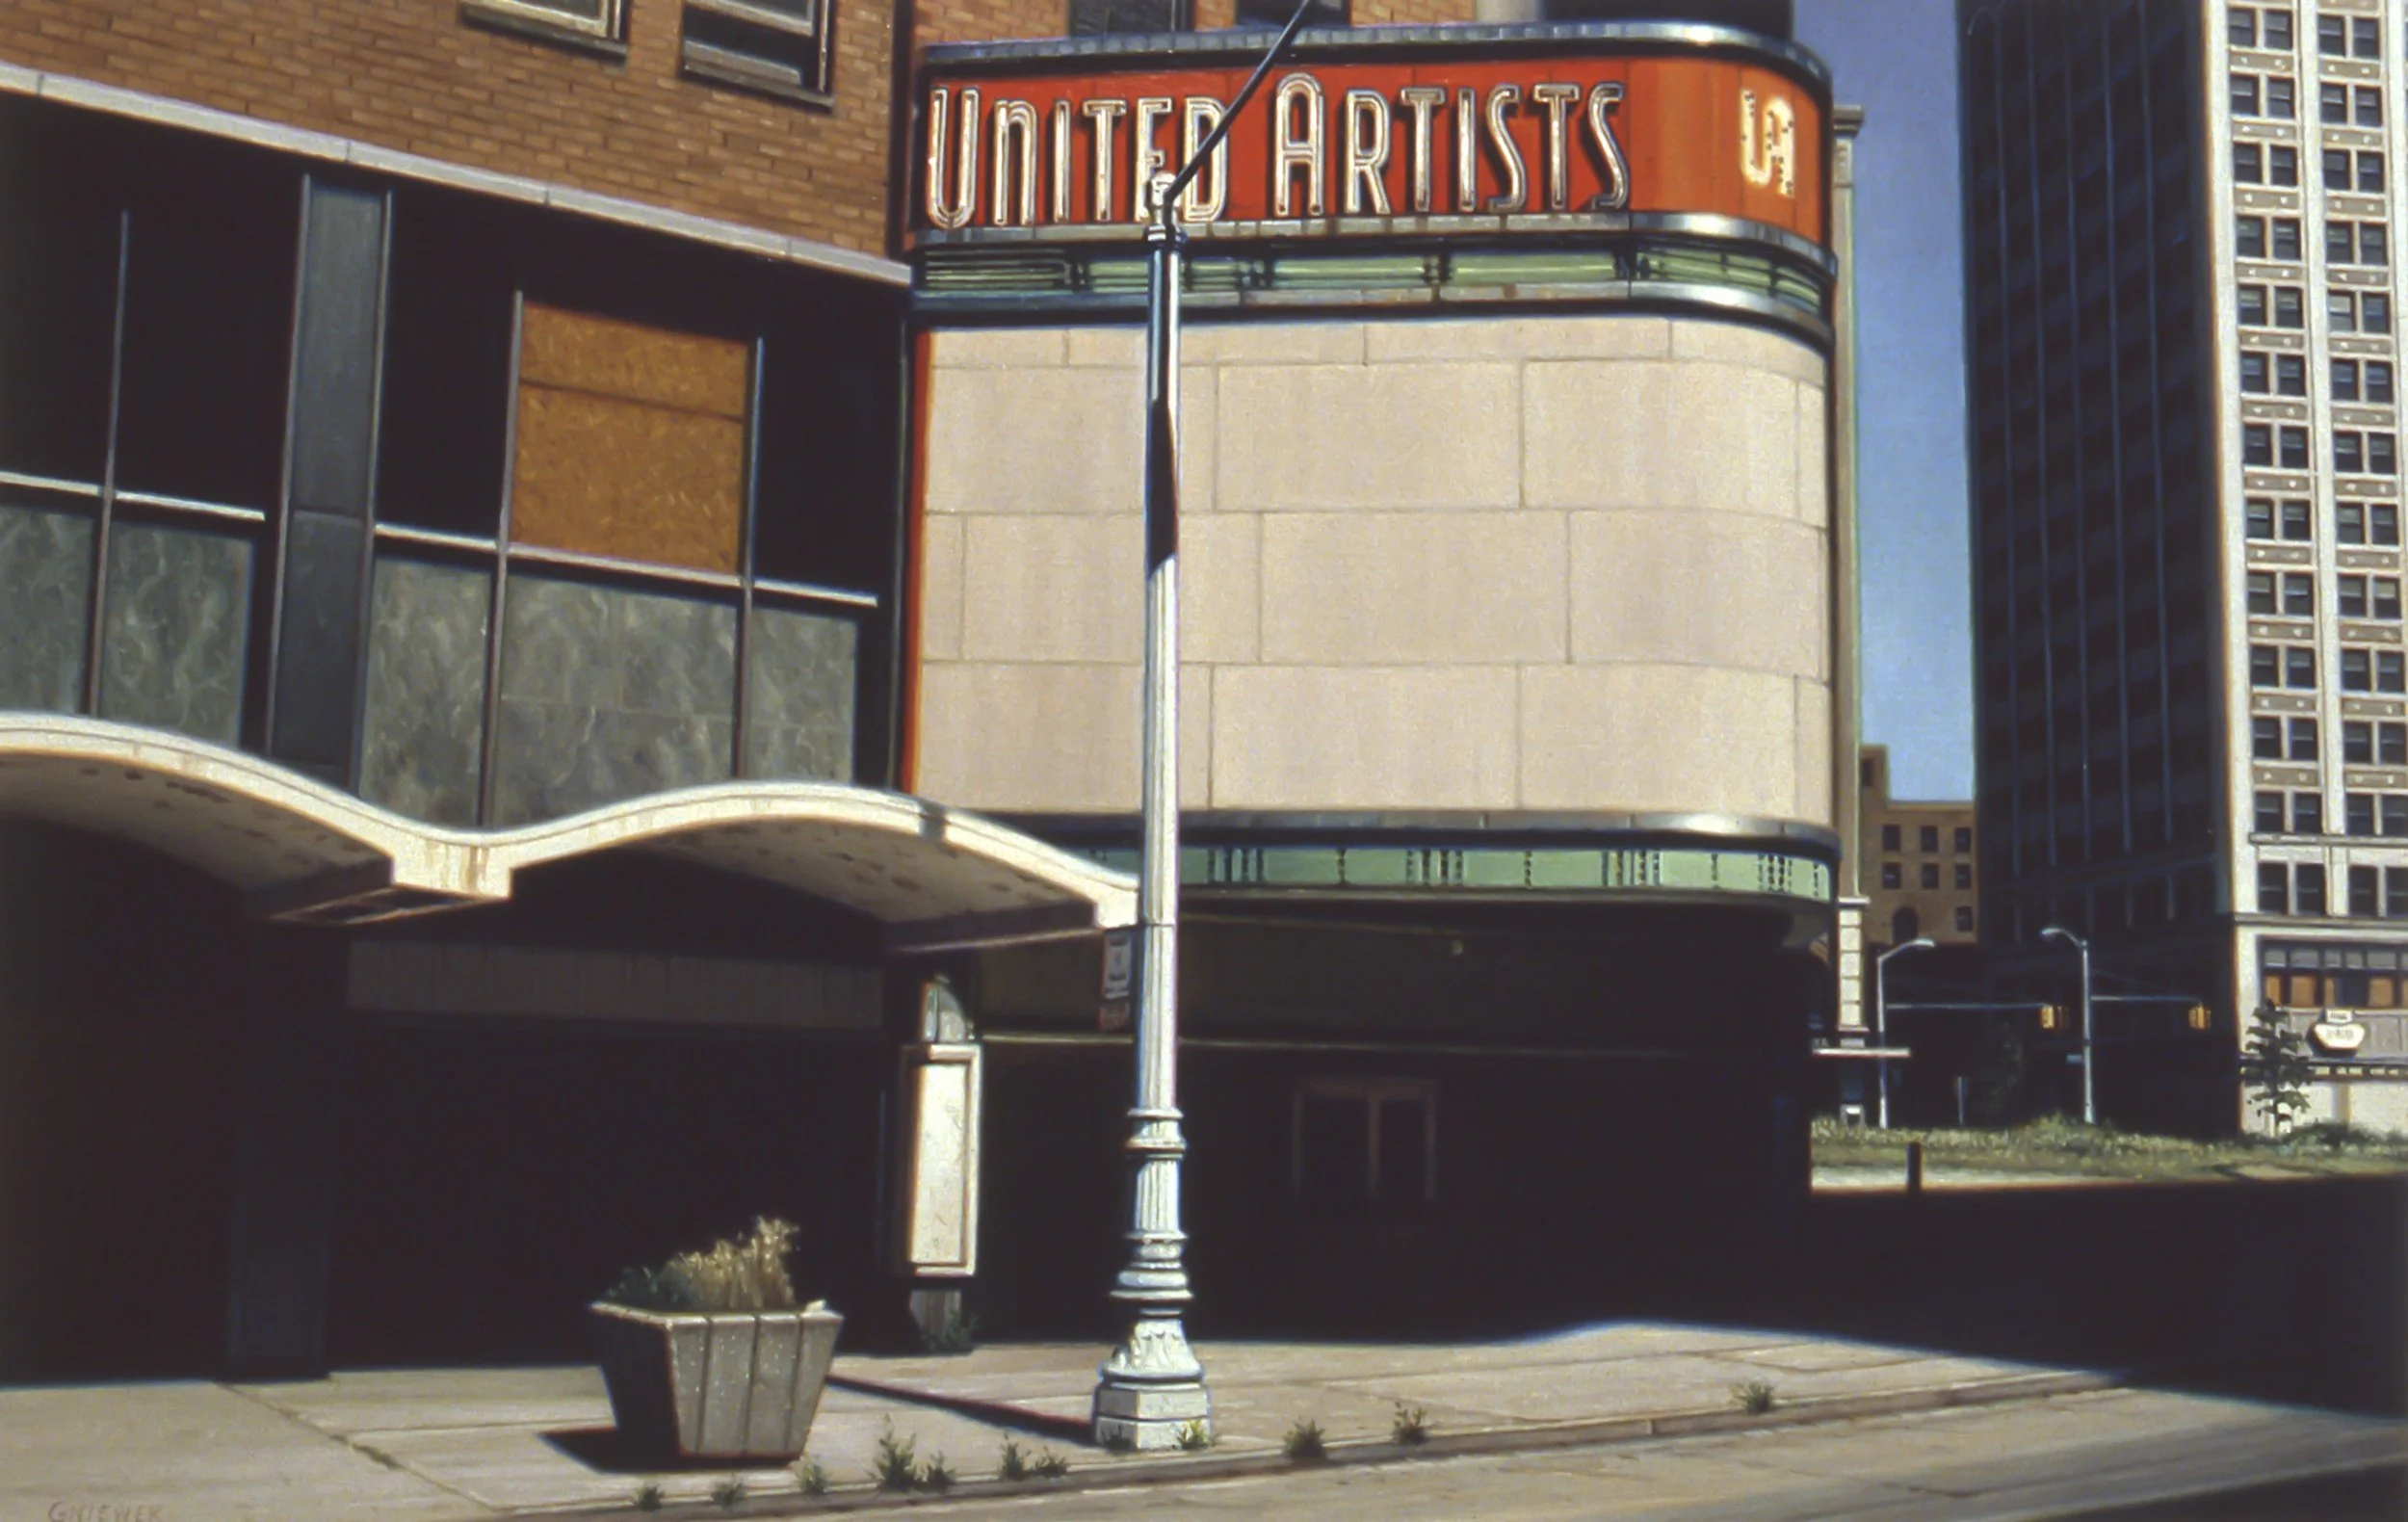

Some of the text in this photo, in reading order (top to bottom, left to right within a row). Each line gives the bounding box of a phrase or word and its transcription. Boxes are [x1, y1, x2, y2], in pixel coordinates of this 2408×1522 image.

[927, 71, 1629, 229] UNITED ARTISTS
[1740, 89, 1794, 198] UA
